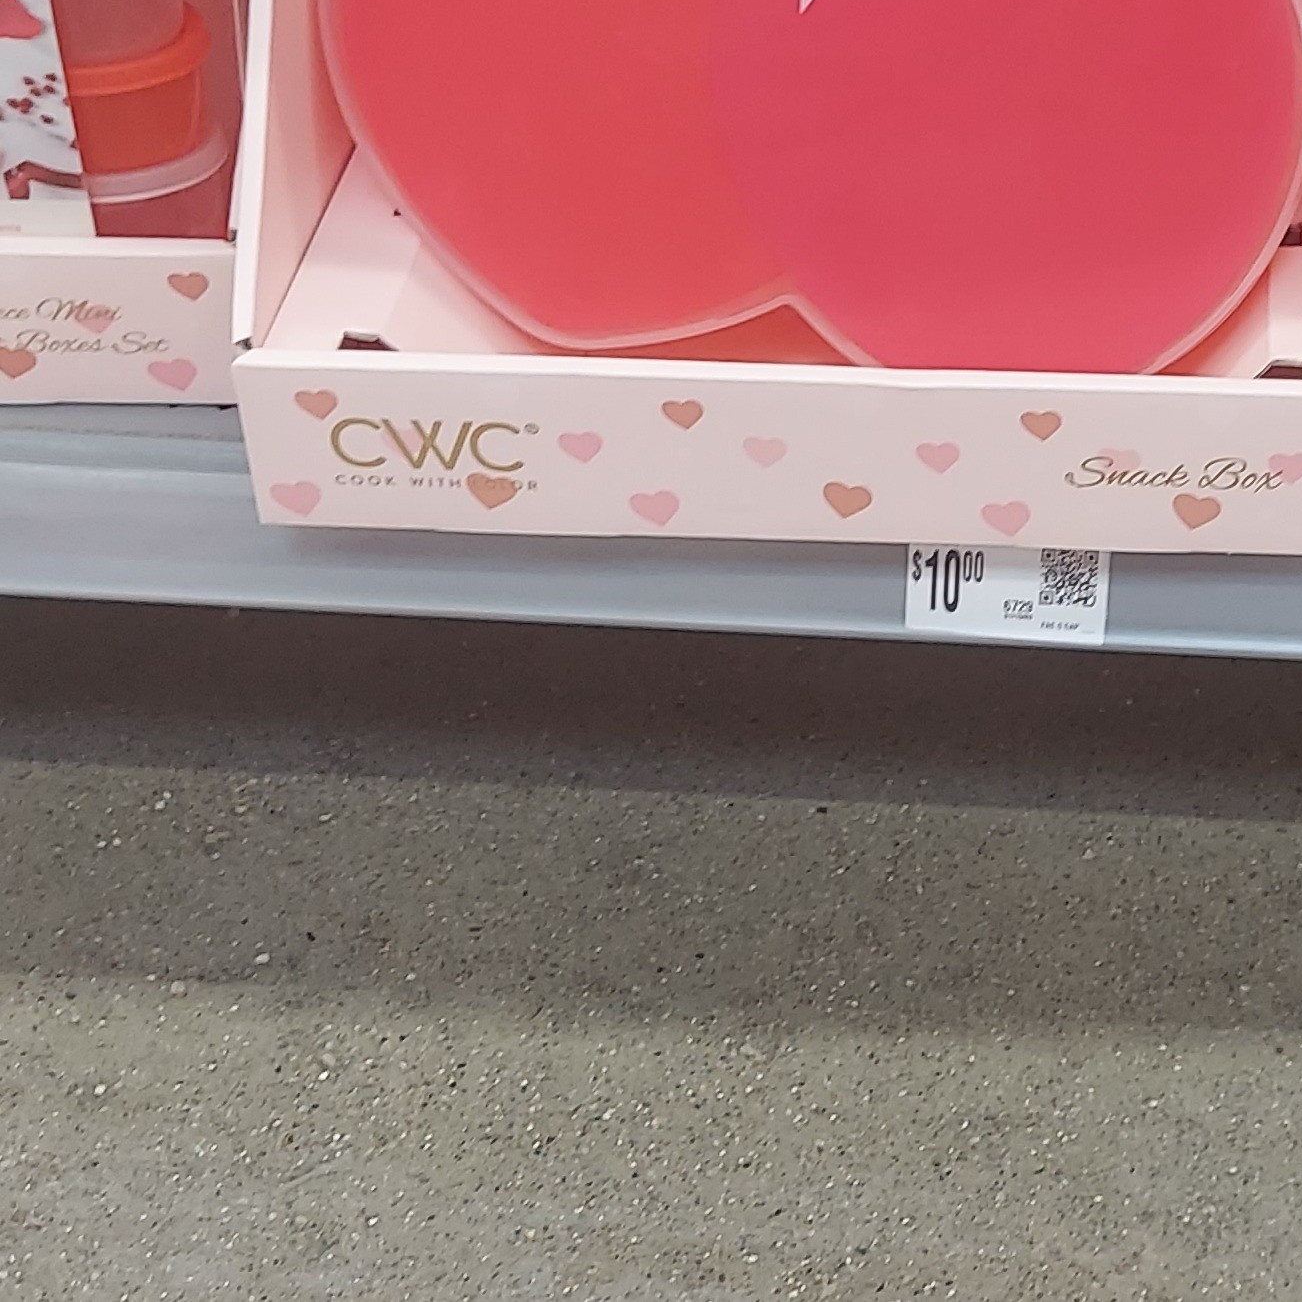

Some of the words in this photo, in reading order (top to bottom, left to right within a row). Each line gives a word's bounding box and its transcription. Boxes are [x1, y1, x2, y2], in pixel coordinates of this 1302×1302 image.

[16, 329, 103, 354] Boxes
[112, 331, 170, 354] Set
[335, 474, 397, 486] COOK
[409, 476, 463, 488] WITH
[1064, 456, 1190, 489] Snack
[1197, 457, 1284, 494] Box
